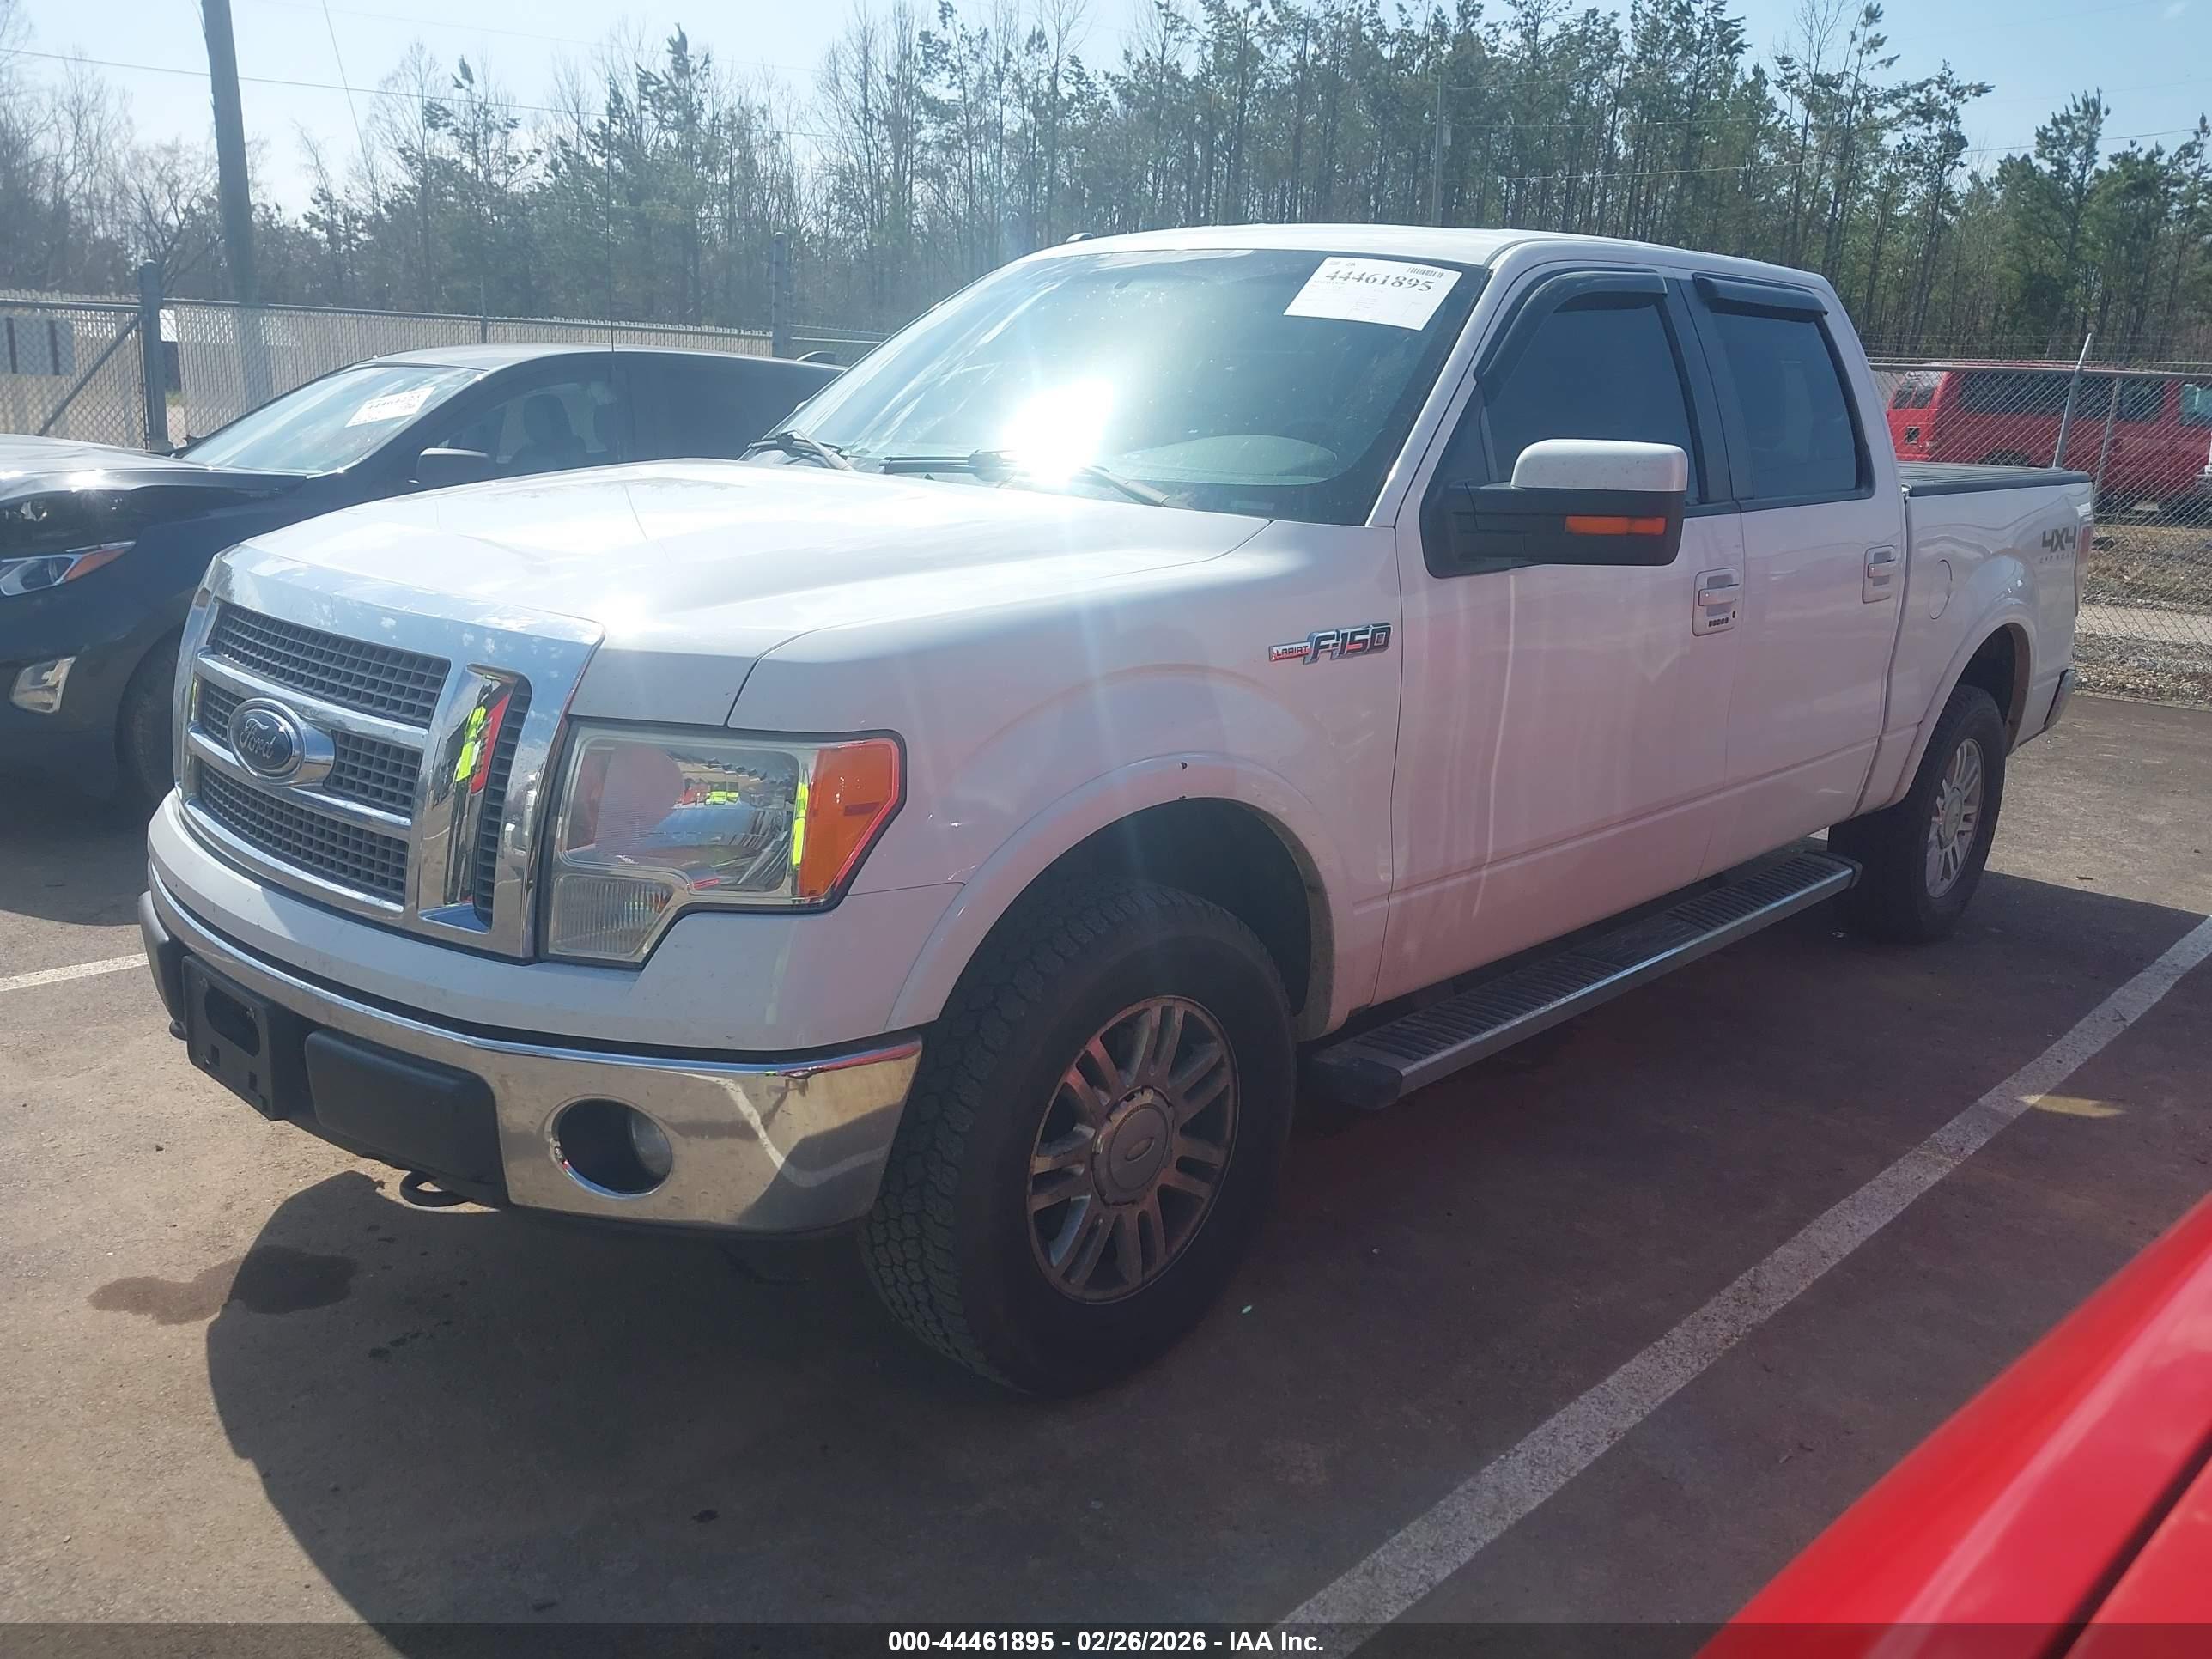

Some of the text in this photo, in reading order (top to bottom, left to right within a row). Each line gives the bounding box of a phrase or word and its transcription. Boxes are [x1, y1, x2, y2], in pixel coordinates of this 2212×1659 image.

[1326, 270, 1436, 292] 44461895
[1275, 645, 1309, 657] LARIAT
[239, 718, 277, 760] Ford
